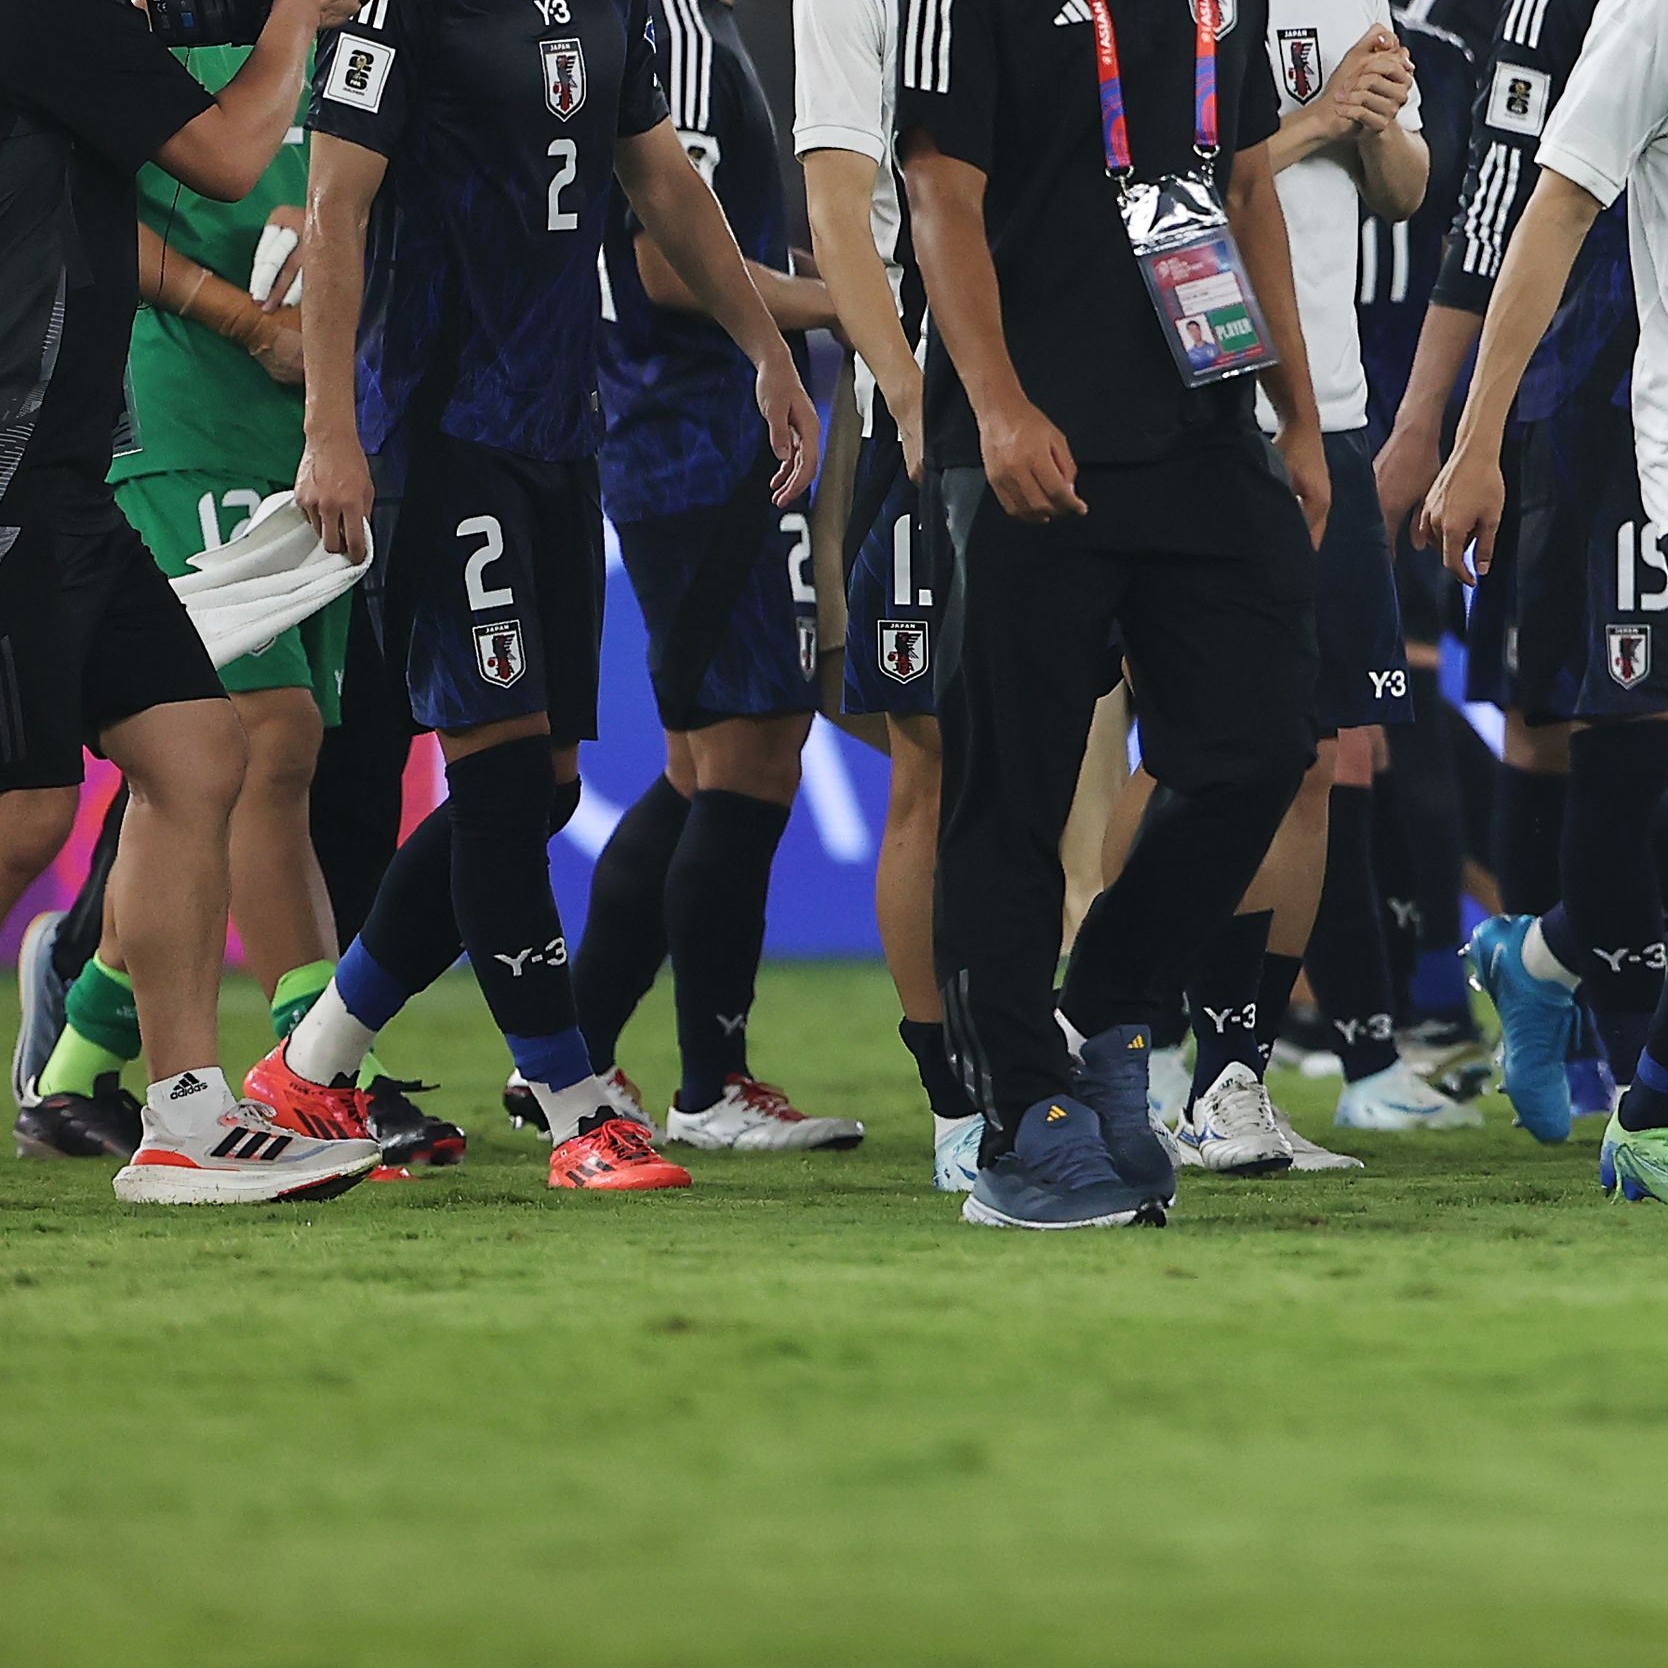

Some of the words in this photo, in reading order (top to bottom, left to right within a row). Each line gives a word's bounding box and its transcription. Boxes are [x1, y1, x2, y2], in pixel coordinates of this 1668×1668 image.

[550, 43, 570, 51] JAPAN
[547, 139, 577, 230] 2
[457, 515, 513, 611] 2
[486, 624, 509, 633] JAPAN
[1369, 670, 1406, 698] Y-3
[494, 937, 567, 976] Y-3
[1592, 943, 1667, 971] Y-3
[1203, 1003, 1256, 1033] Y-3
[170, 1082, 208, 1100] adidas
